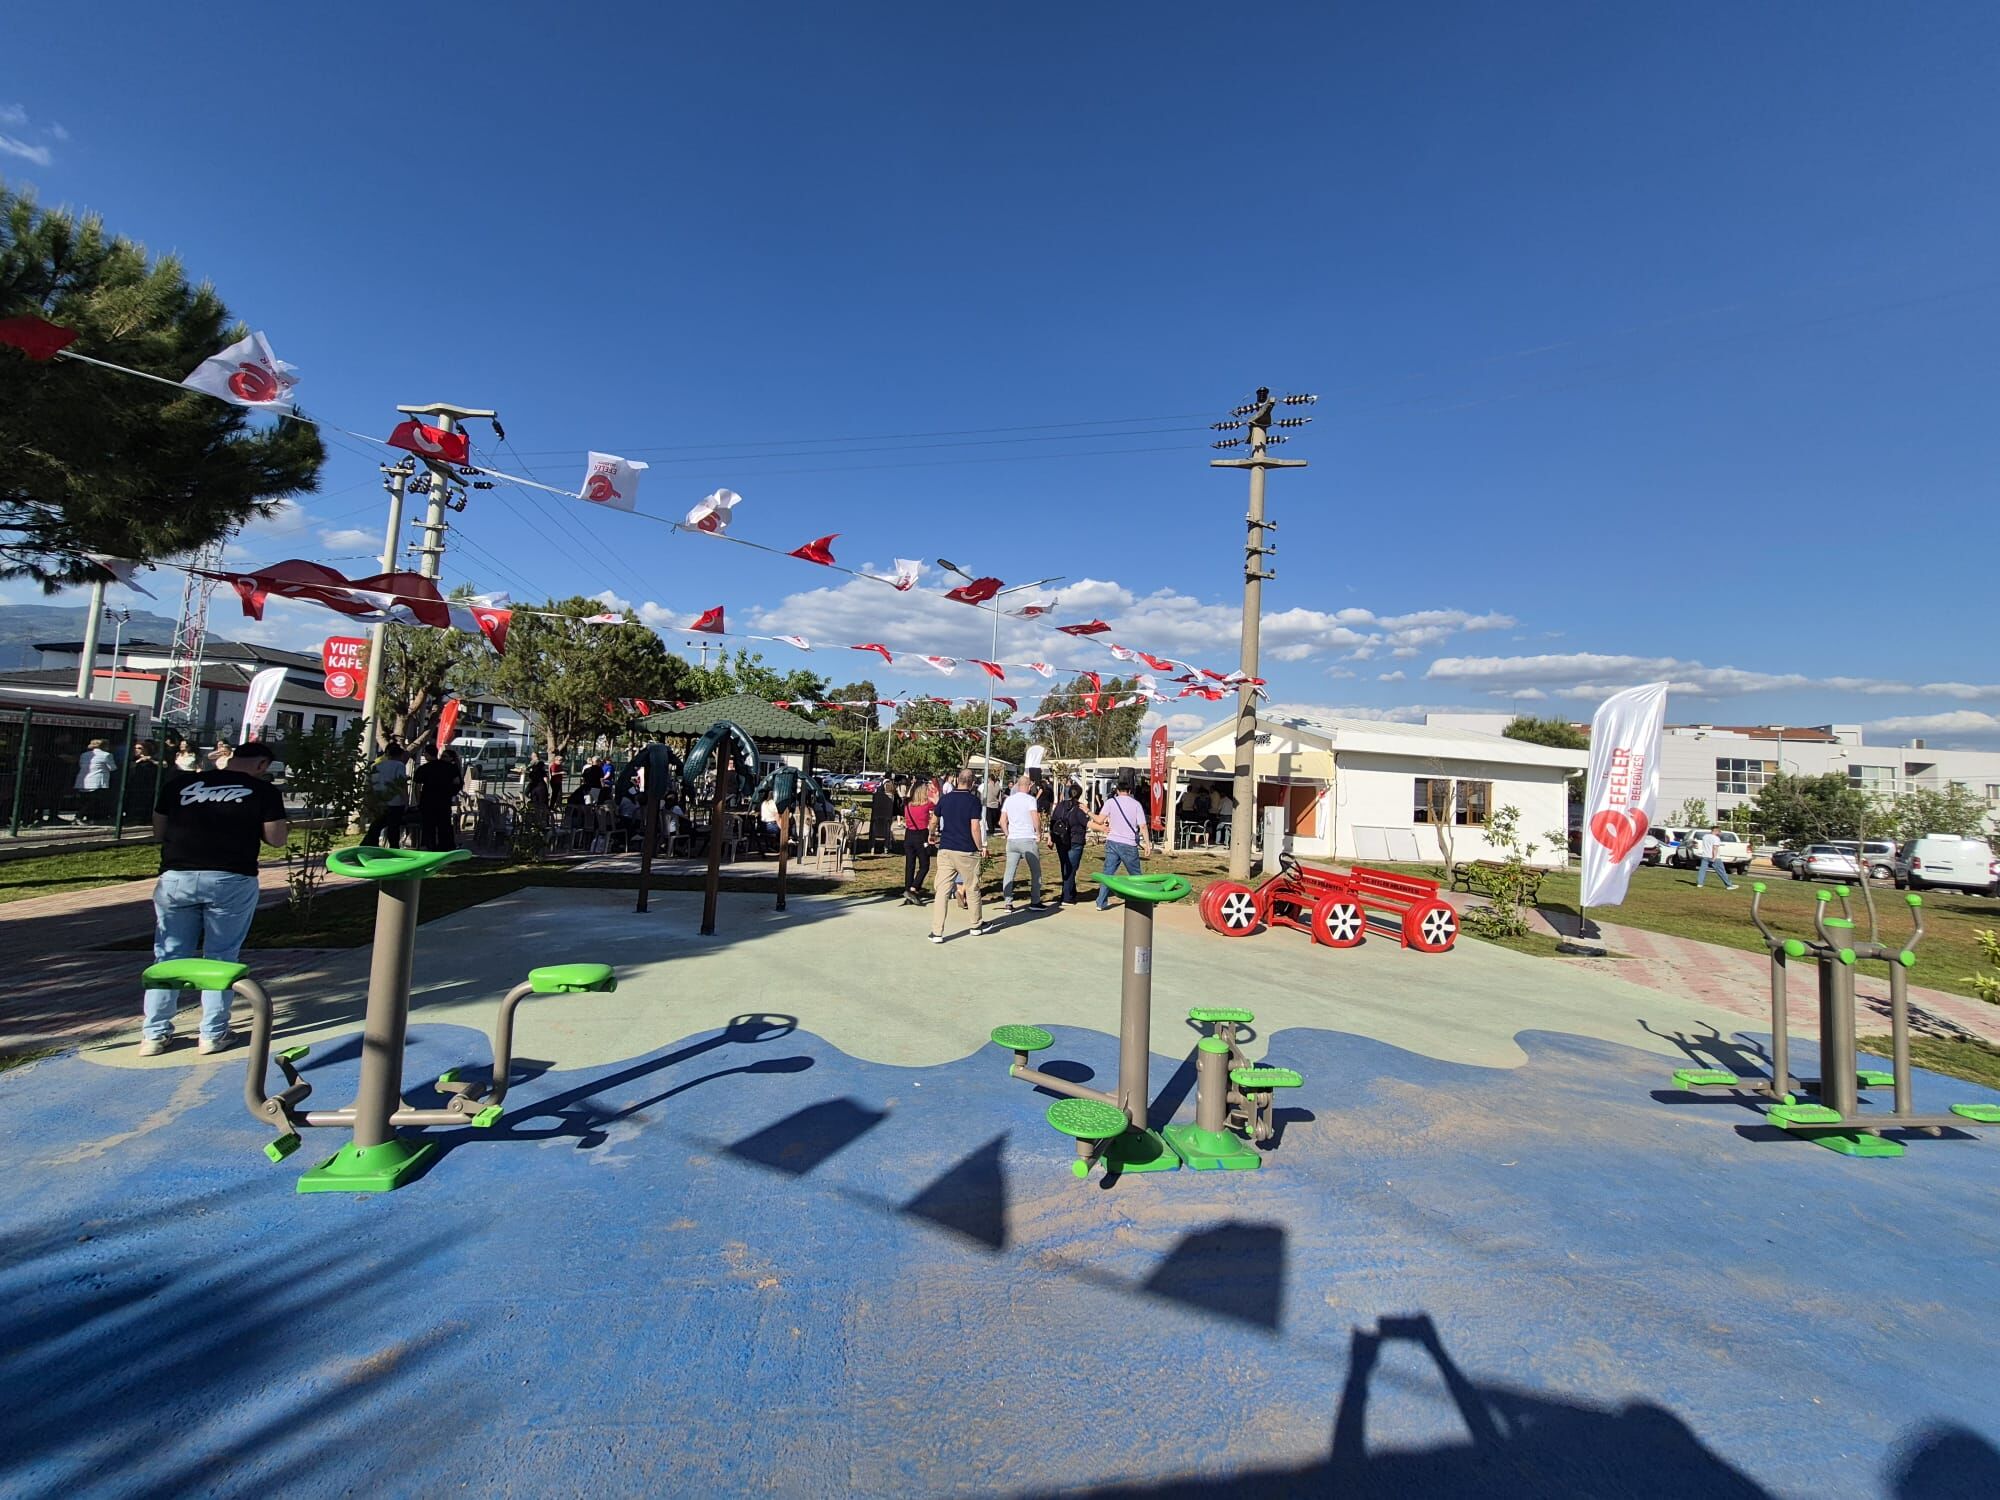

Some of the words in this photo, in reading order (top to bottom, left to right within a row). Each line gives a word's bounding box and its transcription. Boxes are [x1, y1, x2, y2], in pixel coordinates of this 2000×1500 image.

[328, 655, 363, 669] KAFE
[1610, 747, 1631, 805] EFELER
[1631, 754, 1645, 801] BELEDİYESİ
